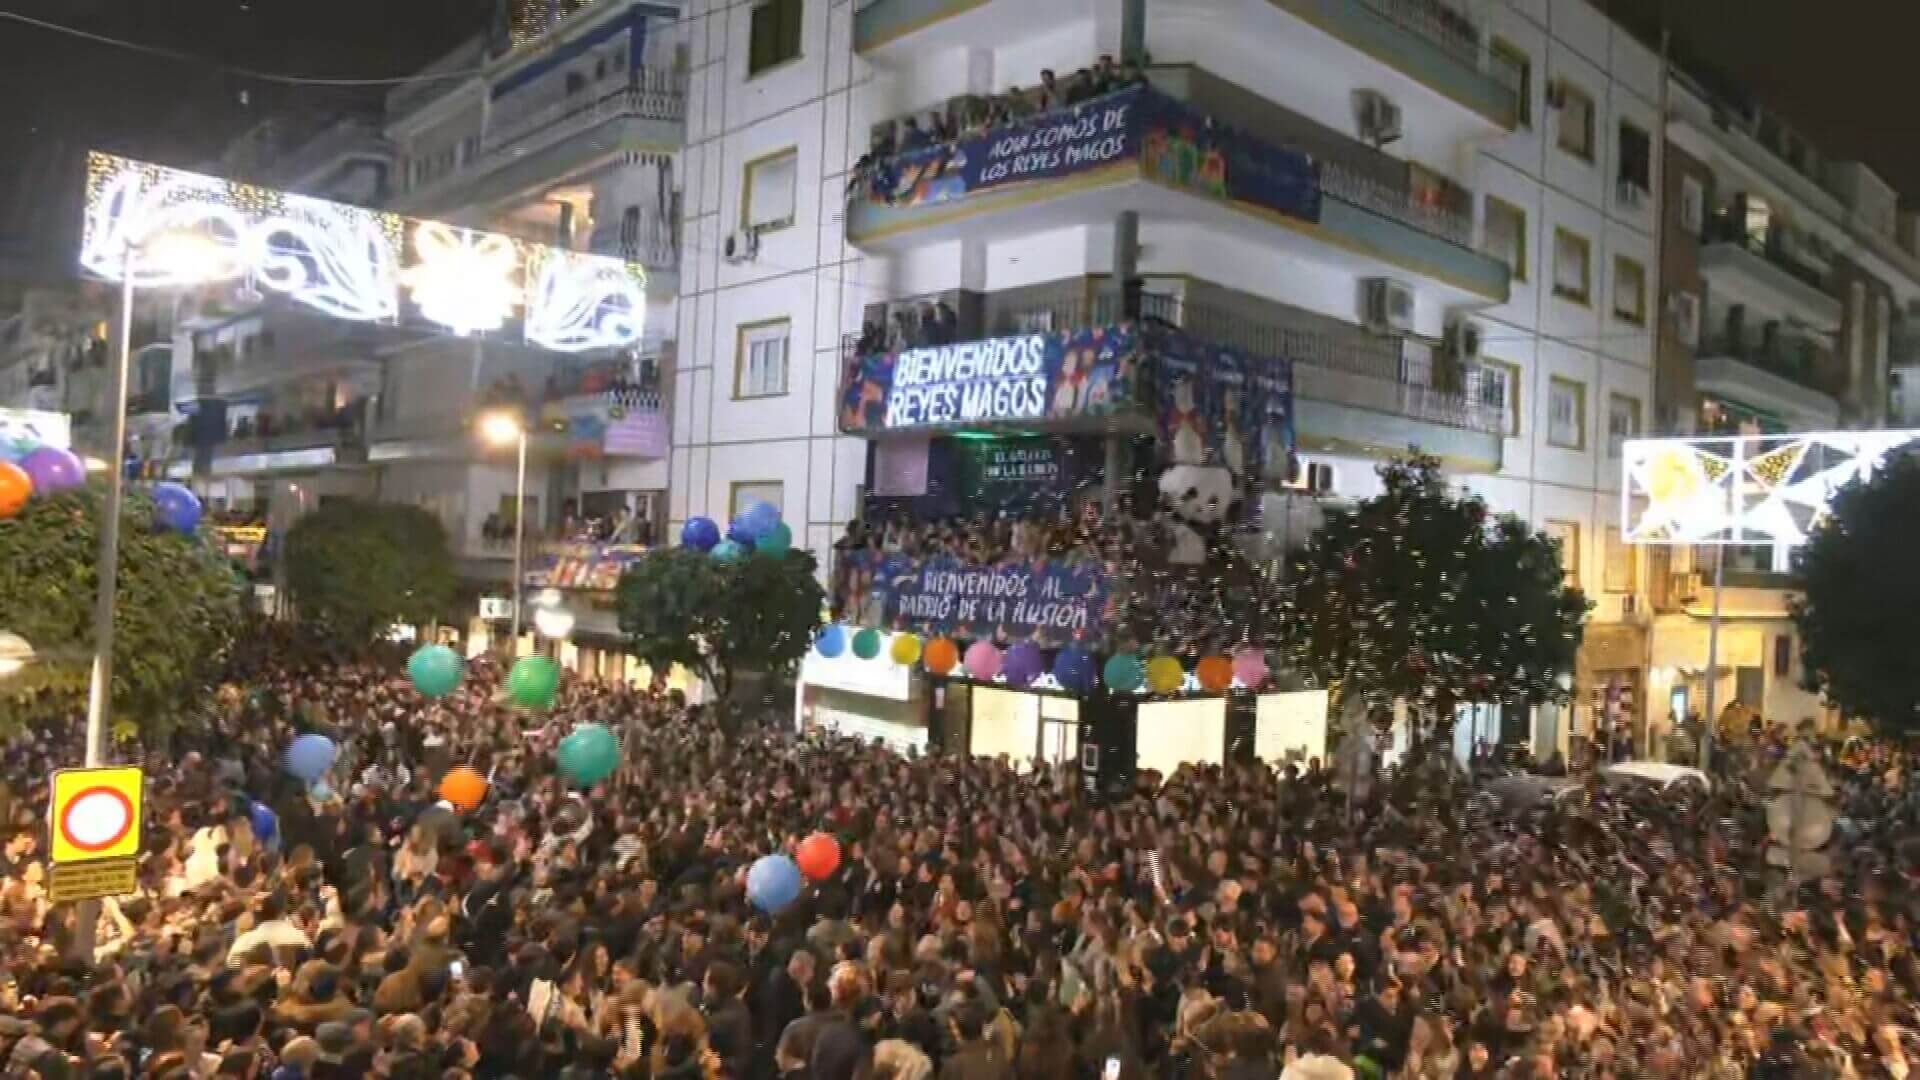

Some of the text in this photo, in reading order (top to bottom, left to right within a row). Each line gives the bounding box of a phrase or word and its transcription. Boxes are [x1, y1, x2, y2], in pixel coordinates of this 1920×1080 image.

[1030, 112, 1099, 148] SOMOS
[1102, 104, 1129, 132] DE
[980, 134, 1127, 183] LOS REYES MAGOS
[894, 334, 1045, 388] BIENVENIDOS
[886, 377, 1047, 429] REYES MAGOS
[924, 570, 1065, 599] BIENVENIDOS AL
[958, 597, 980, 621] DE
[986, 600, 1006, 623] LA
